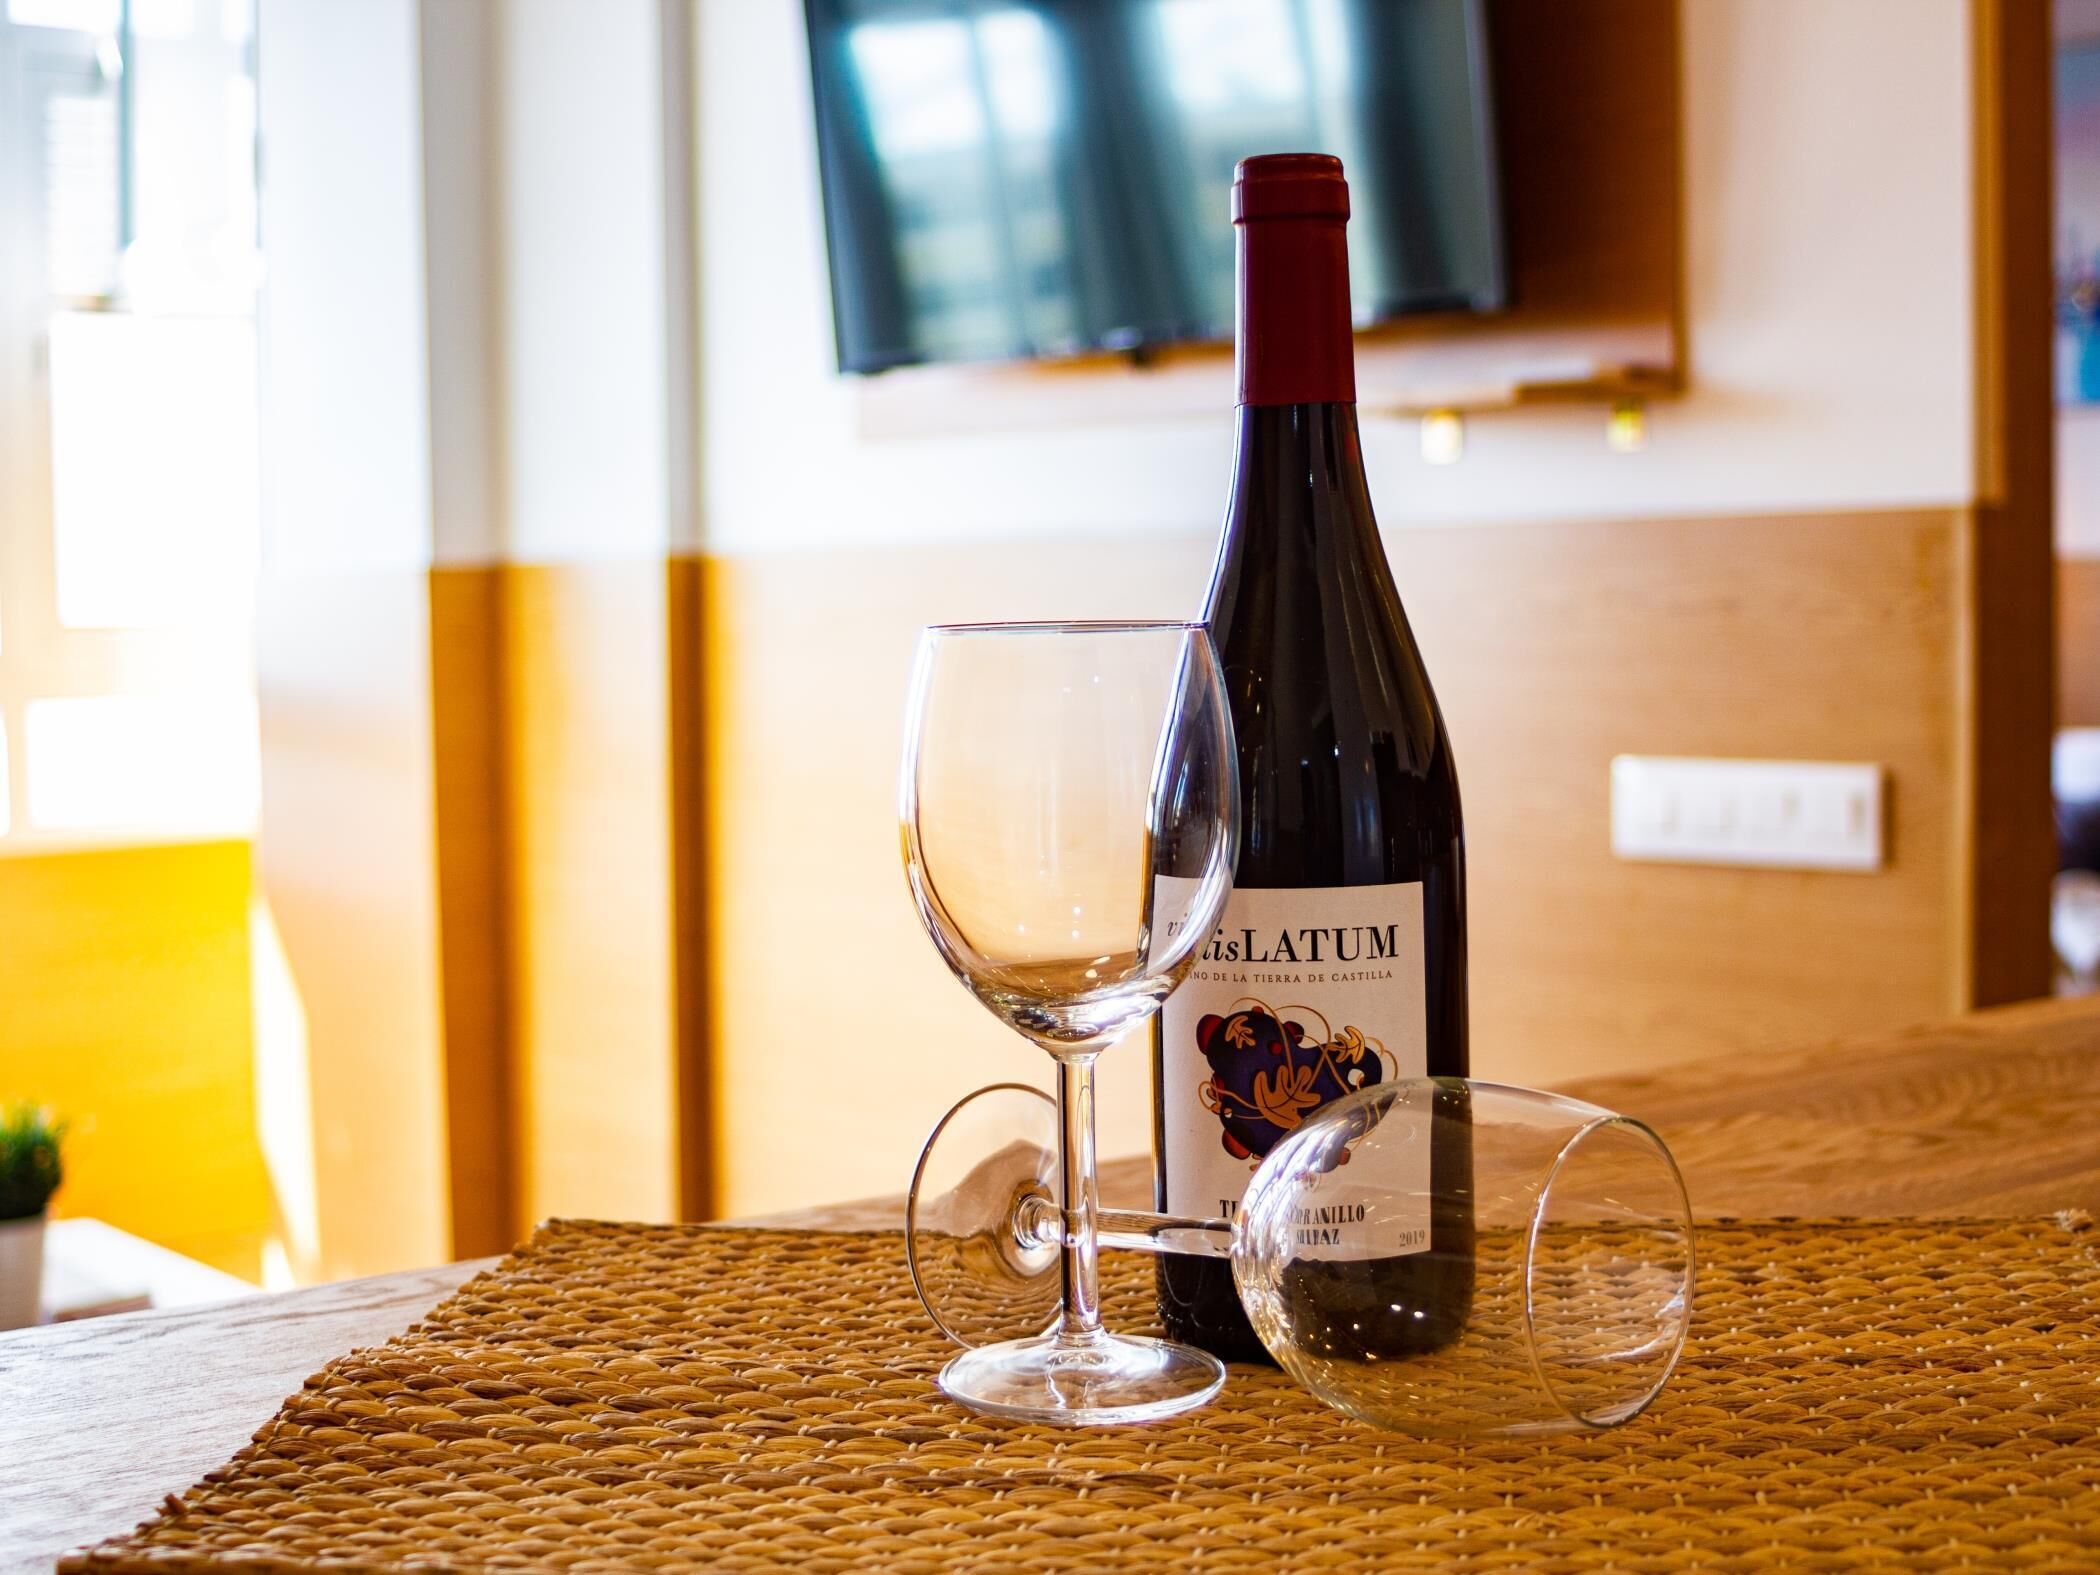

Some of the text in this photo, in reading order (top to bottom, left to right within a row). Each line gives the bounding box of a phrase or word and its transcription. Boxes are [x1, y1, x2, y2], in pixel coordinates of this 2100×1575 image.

[1213, 972, 1227, 982] DE
[1233, 973, 1248, 983] LA
[1253, 974, 1301, 983] TIERRA
[1308, 973, 1325, 983] DE
[1332, 970, 1393, 982] CASTILLA
[1219, 1199, 1365, 1225] TPRANILLO
[1399, 1229, 1425, 1247] 2019
